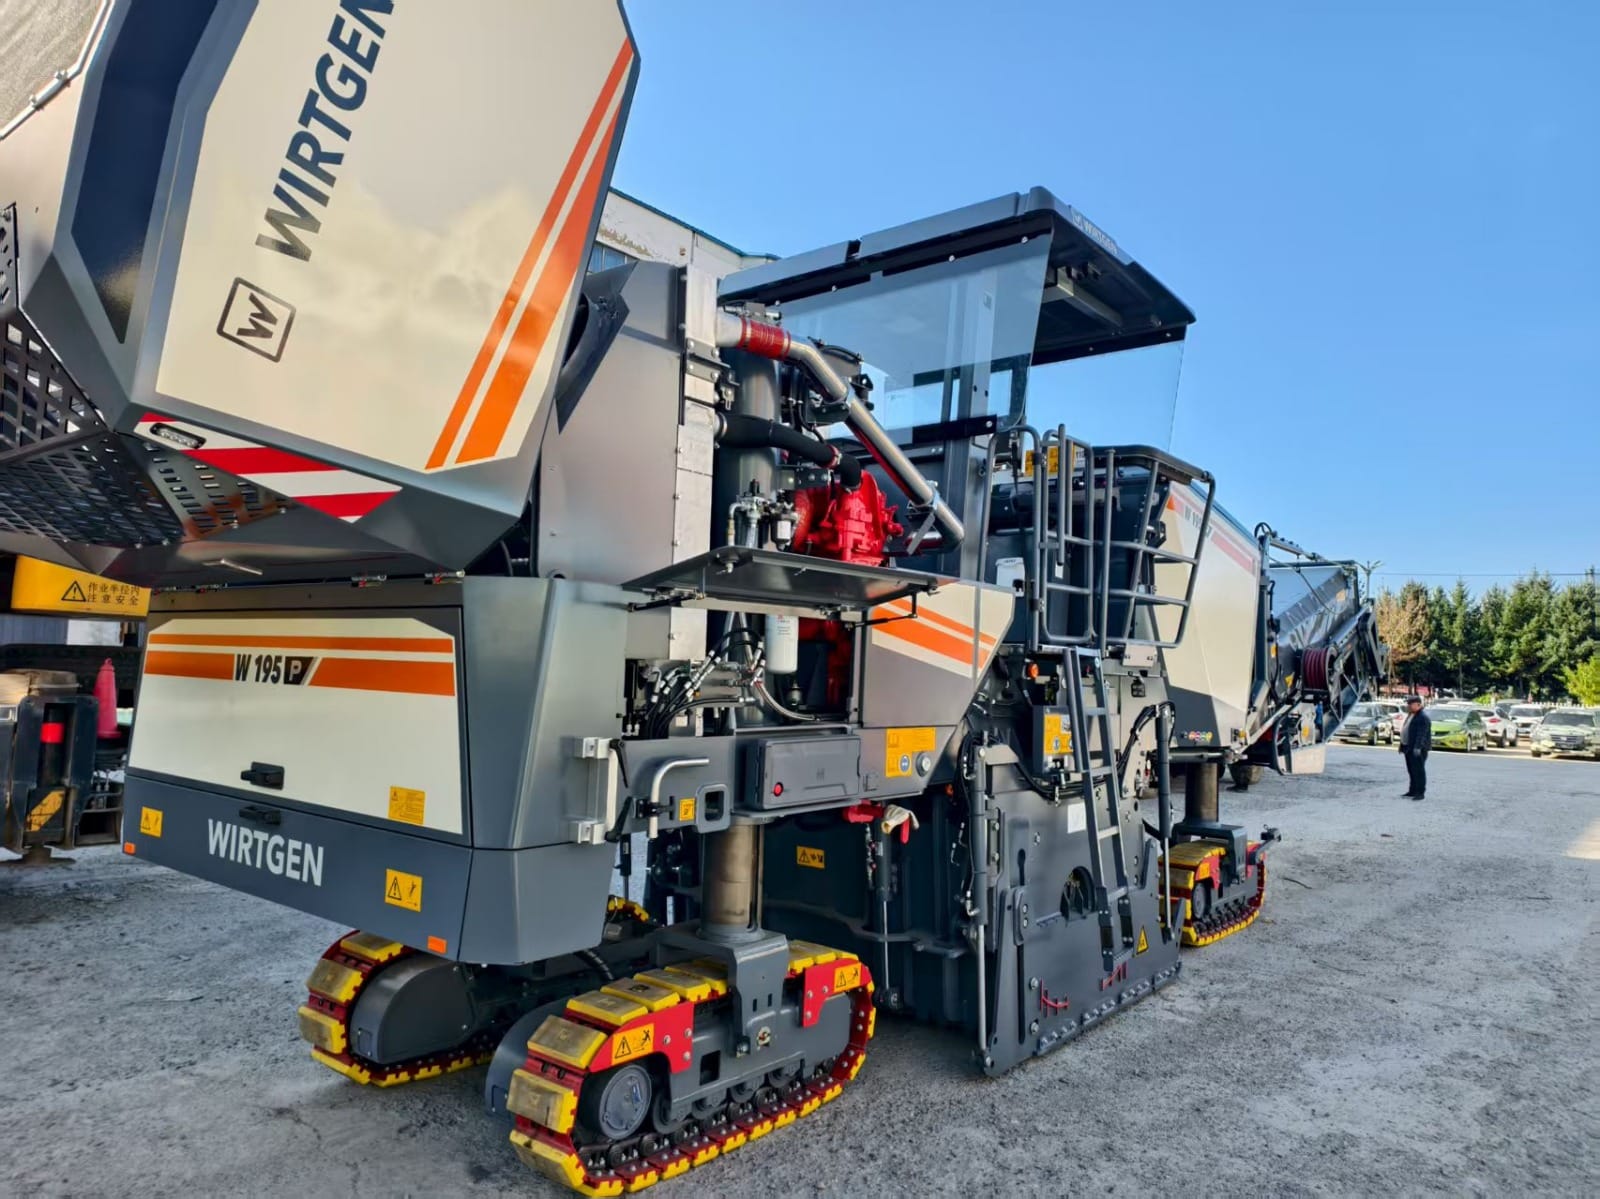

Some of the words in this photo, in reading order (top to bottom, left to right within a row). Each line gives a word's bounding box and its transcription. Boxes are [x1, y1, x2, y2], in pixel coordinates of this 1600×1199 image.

[255, 0, 394, 262] WIRTGEN
[235, 653, 252, 682] W
[254, 654, 282, 684] 195
[208, 818, 324, 887] WIRTGEN
